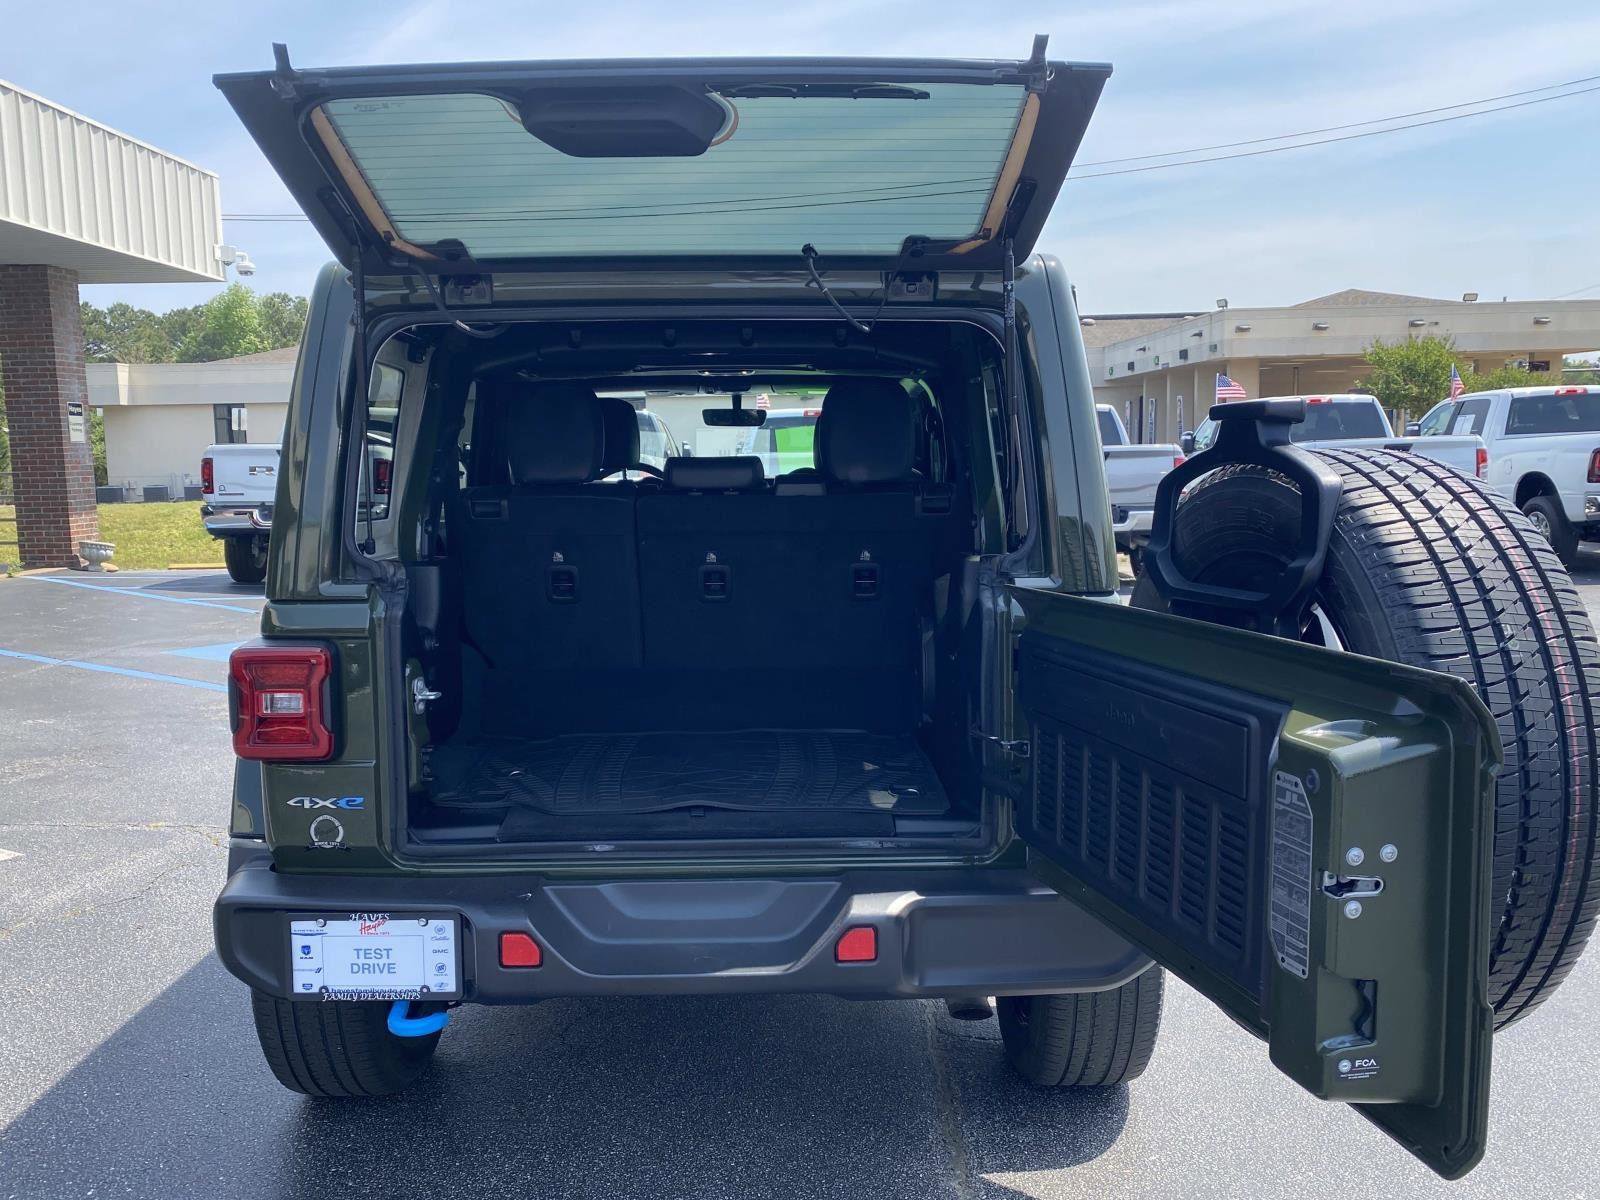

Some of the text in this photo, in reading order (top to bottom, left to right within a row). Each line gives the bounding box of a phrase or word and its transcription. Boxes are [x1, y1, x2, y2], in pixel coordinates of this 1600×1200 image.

[353, 948, 393, 960] TEST
[350, 962, 397, 975] DRIVE
[322, 991, 421, 1002] FAMILY DEALERSHIPS
[1355, 1058, 1377, 1067] FCA
